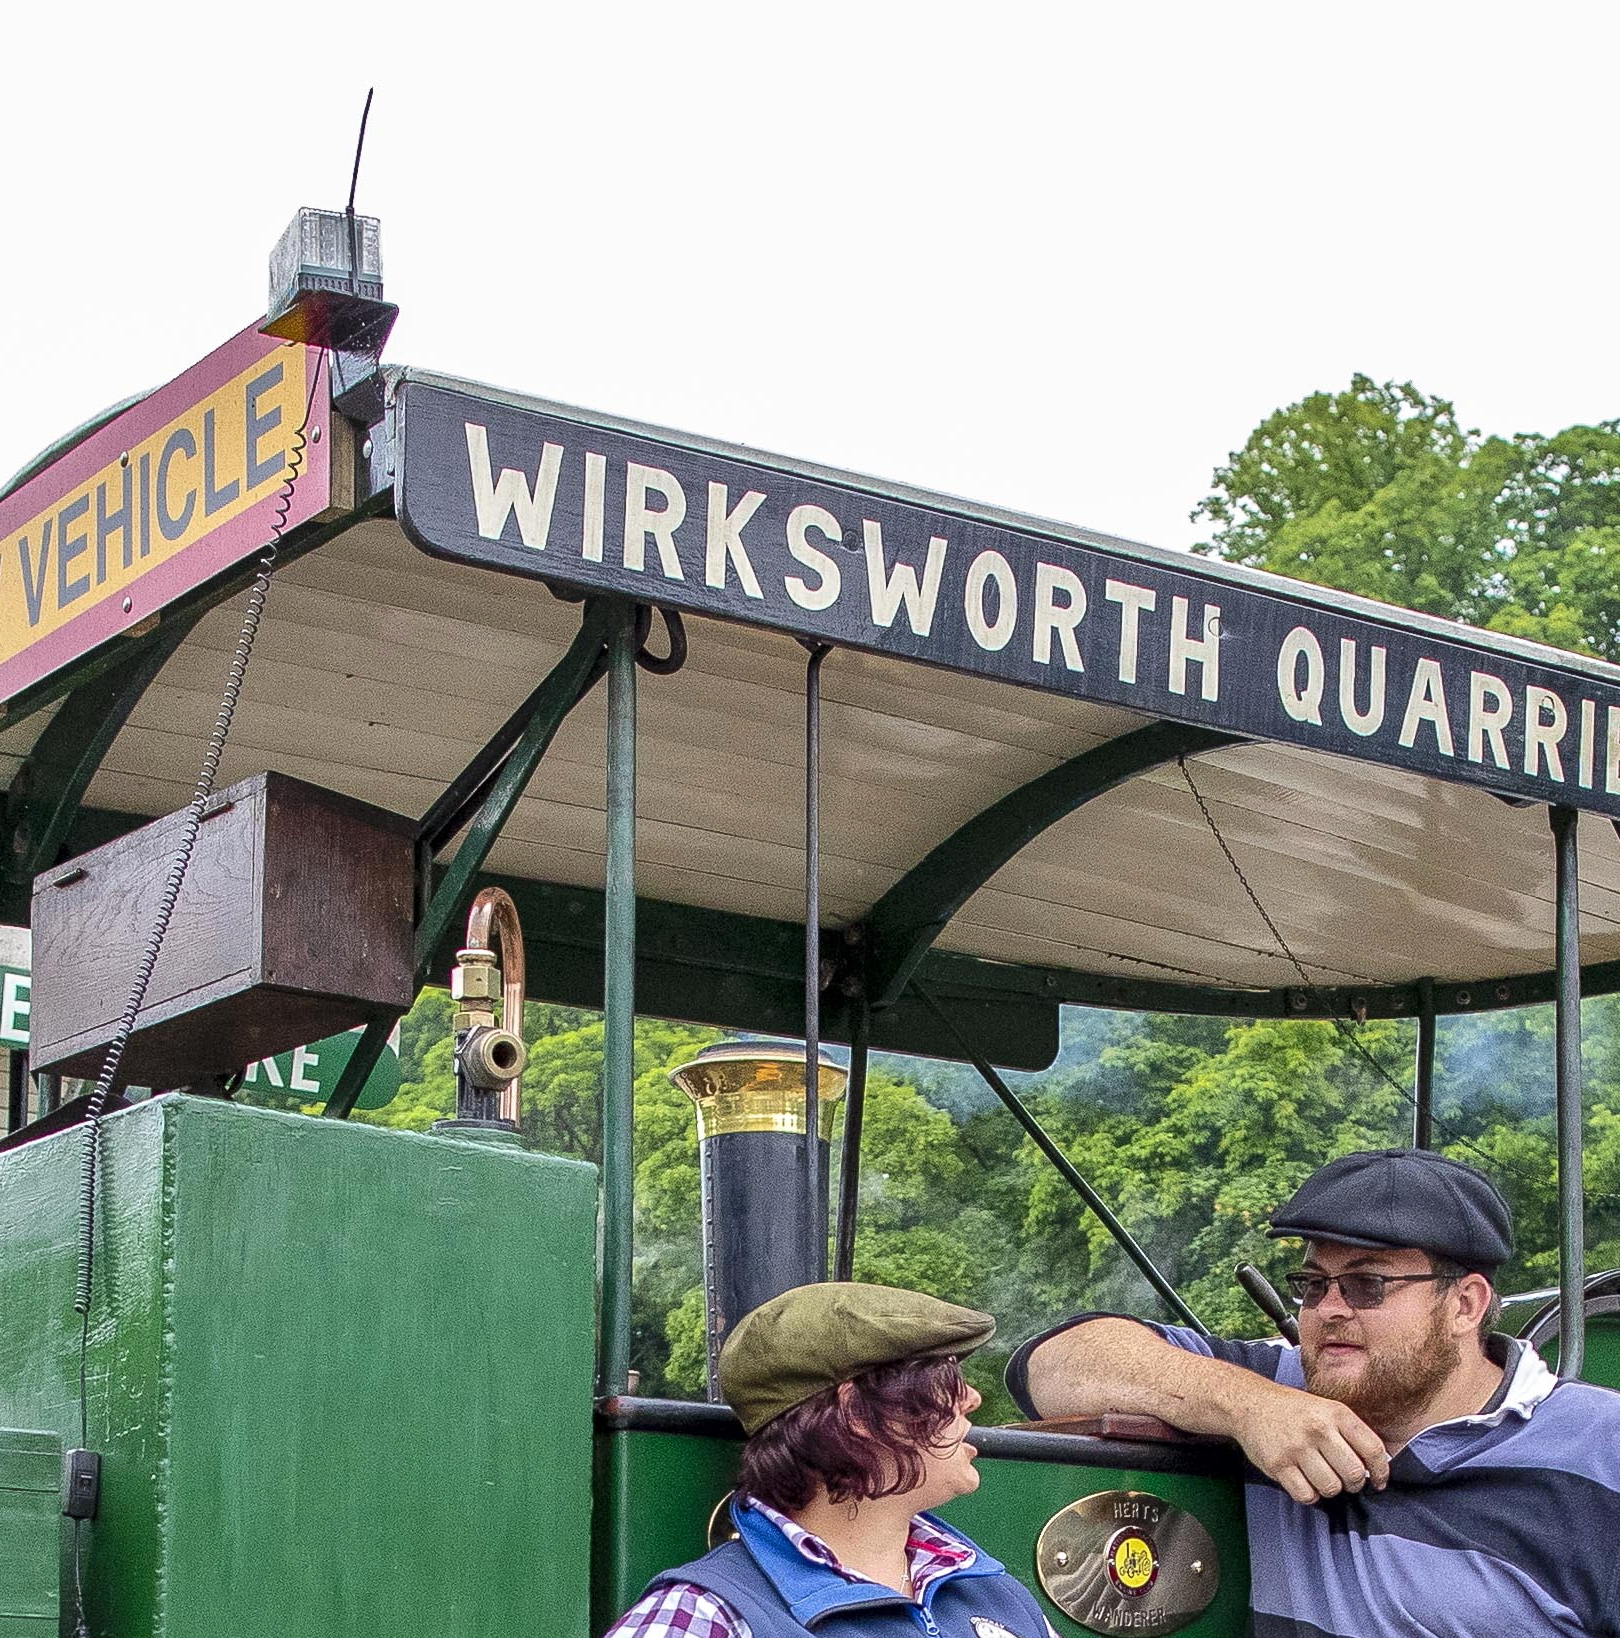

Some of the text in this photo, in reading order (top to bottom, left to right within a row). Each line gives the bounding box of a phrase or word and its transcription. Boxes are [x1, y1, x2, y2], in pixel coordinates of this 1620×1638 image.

[18, 361, 286, 628] VEHICLE
[464, 421, 1222, 703] WIRKSWORTH
[1113, 1501, 1160, 1523] HERTS
[1093, 1605, 1167, 1629] WANDERER
